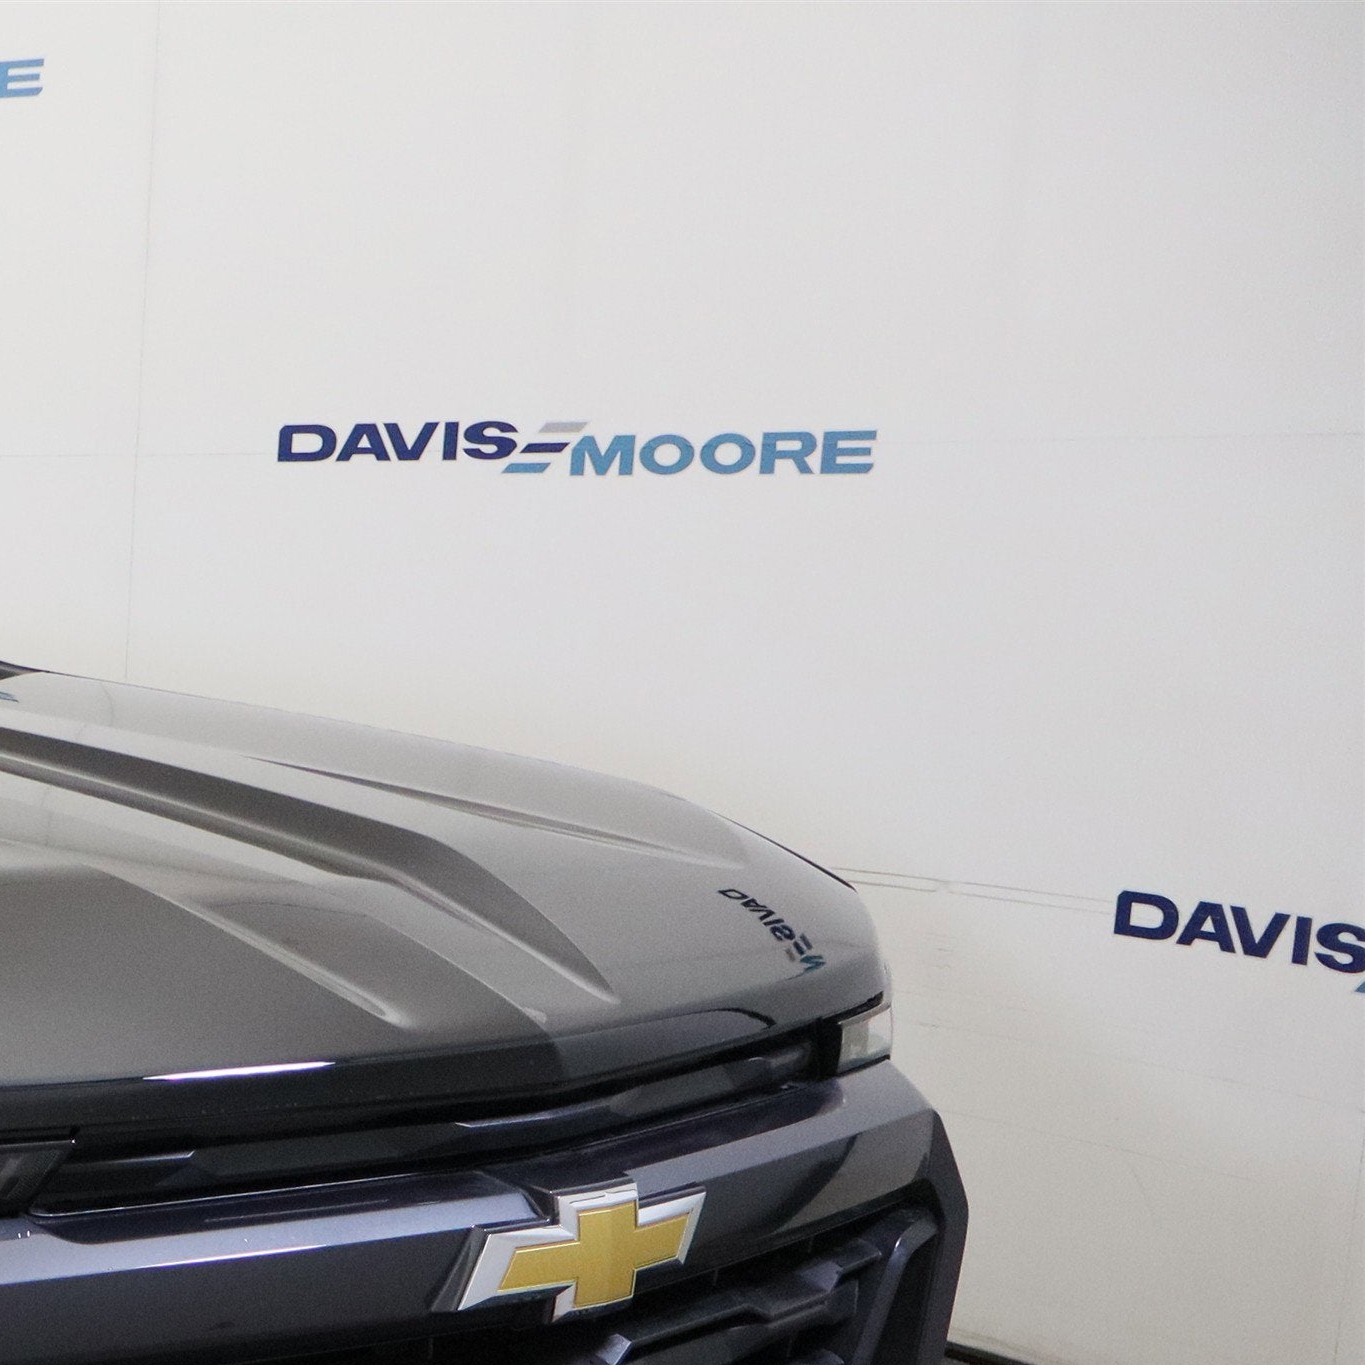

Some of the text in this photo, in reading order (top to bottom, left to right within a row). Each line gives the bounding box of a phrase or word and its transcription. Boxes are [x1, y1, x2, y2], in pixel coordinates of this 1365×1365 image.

[276, 420, 878, 476] DAVIS MOORE
[1113, 890, 1365, 975] DAVIS
